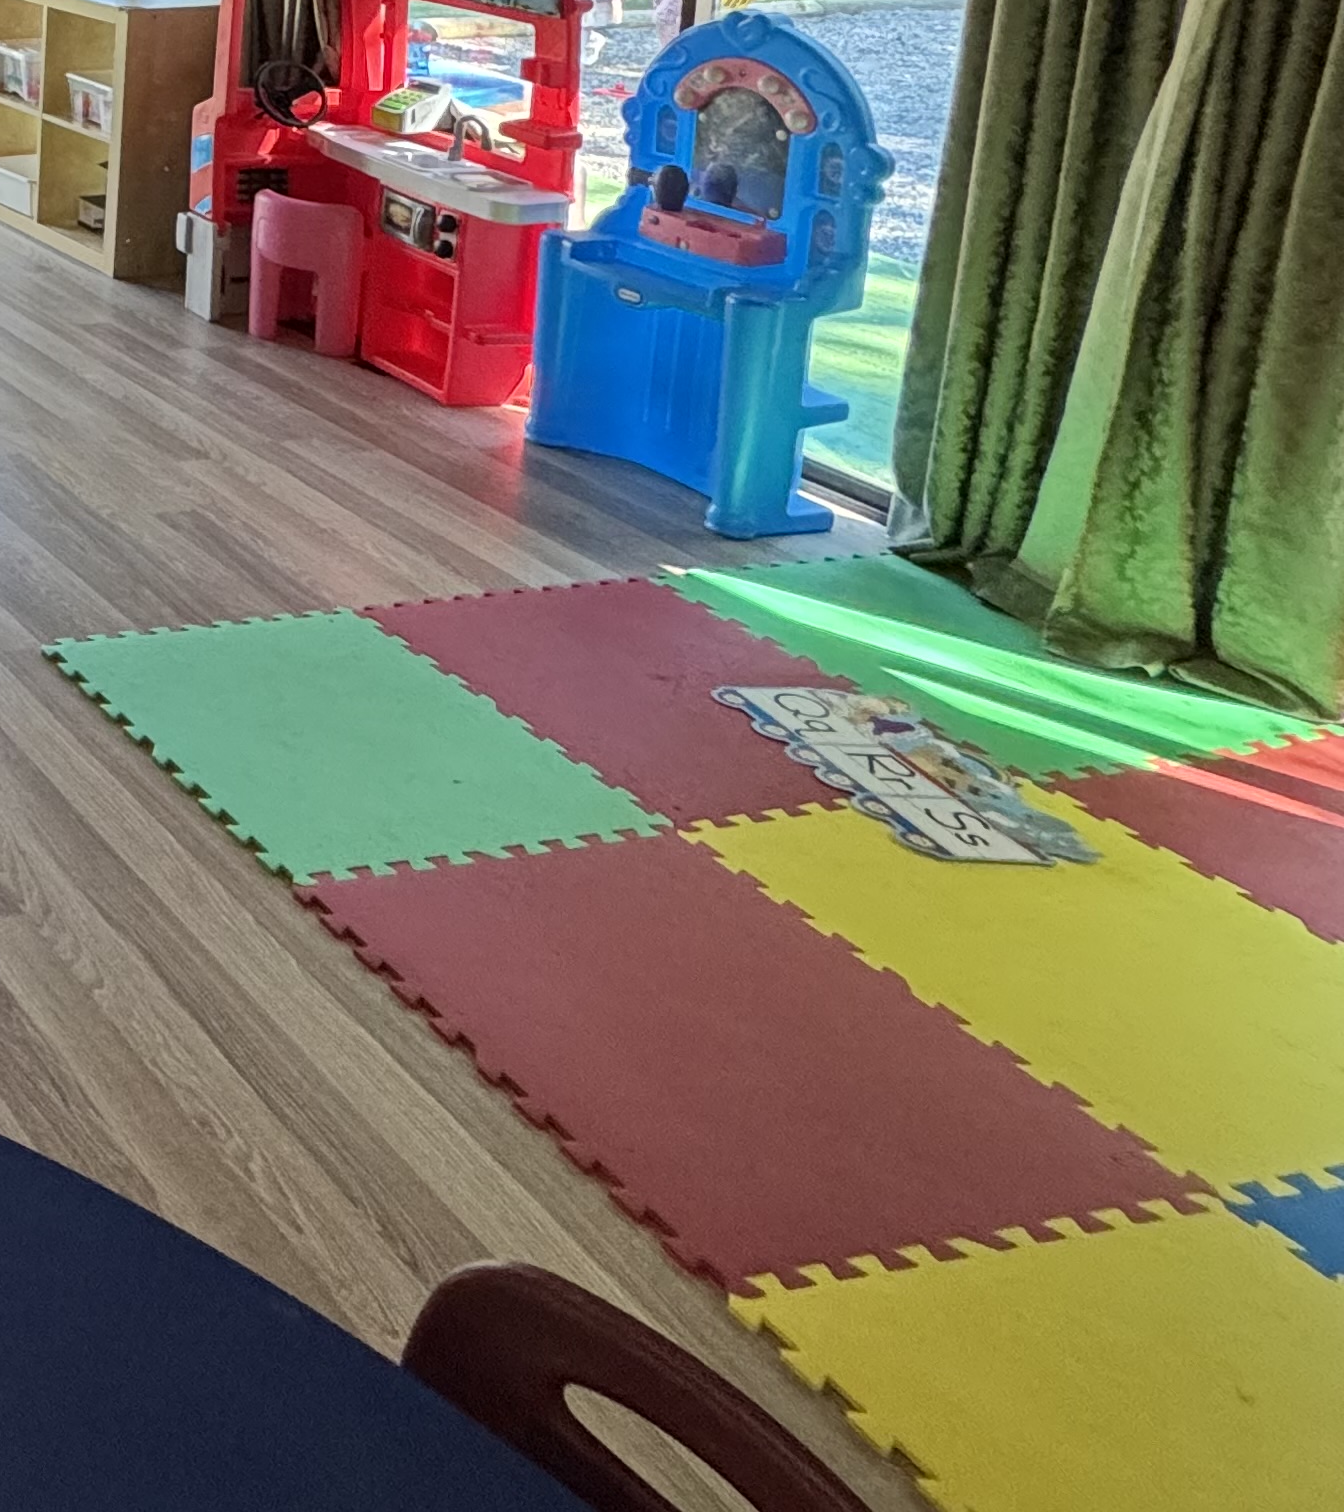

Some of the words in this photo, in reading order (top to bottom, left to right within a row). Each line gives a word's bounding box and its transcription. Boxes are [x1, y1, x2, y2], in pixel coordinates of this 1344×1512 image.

[772, 691, 837, 738] Qq
[844, 749, 917, 792] Rr
[924, 806, 990, 850] Ss
